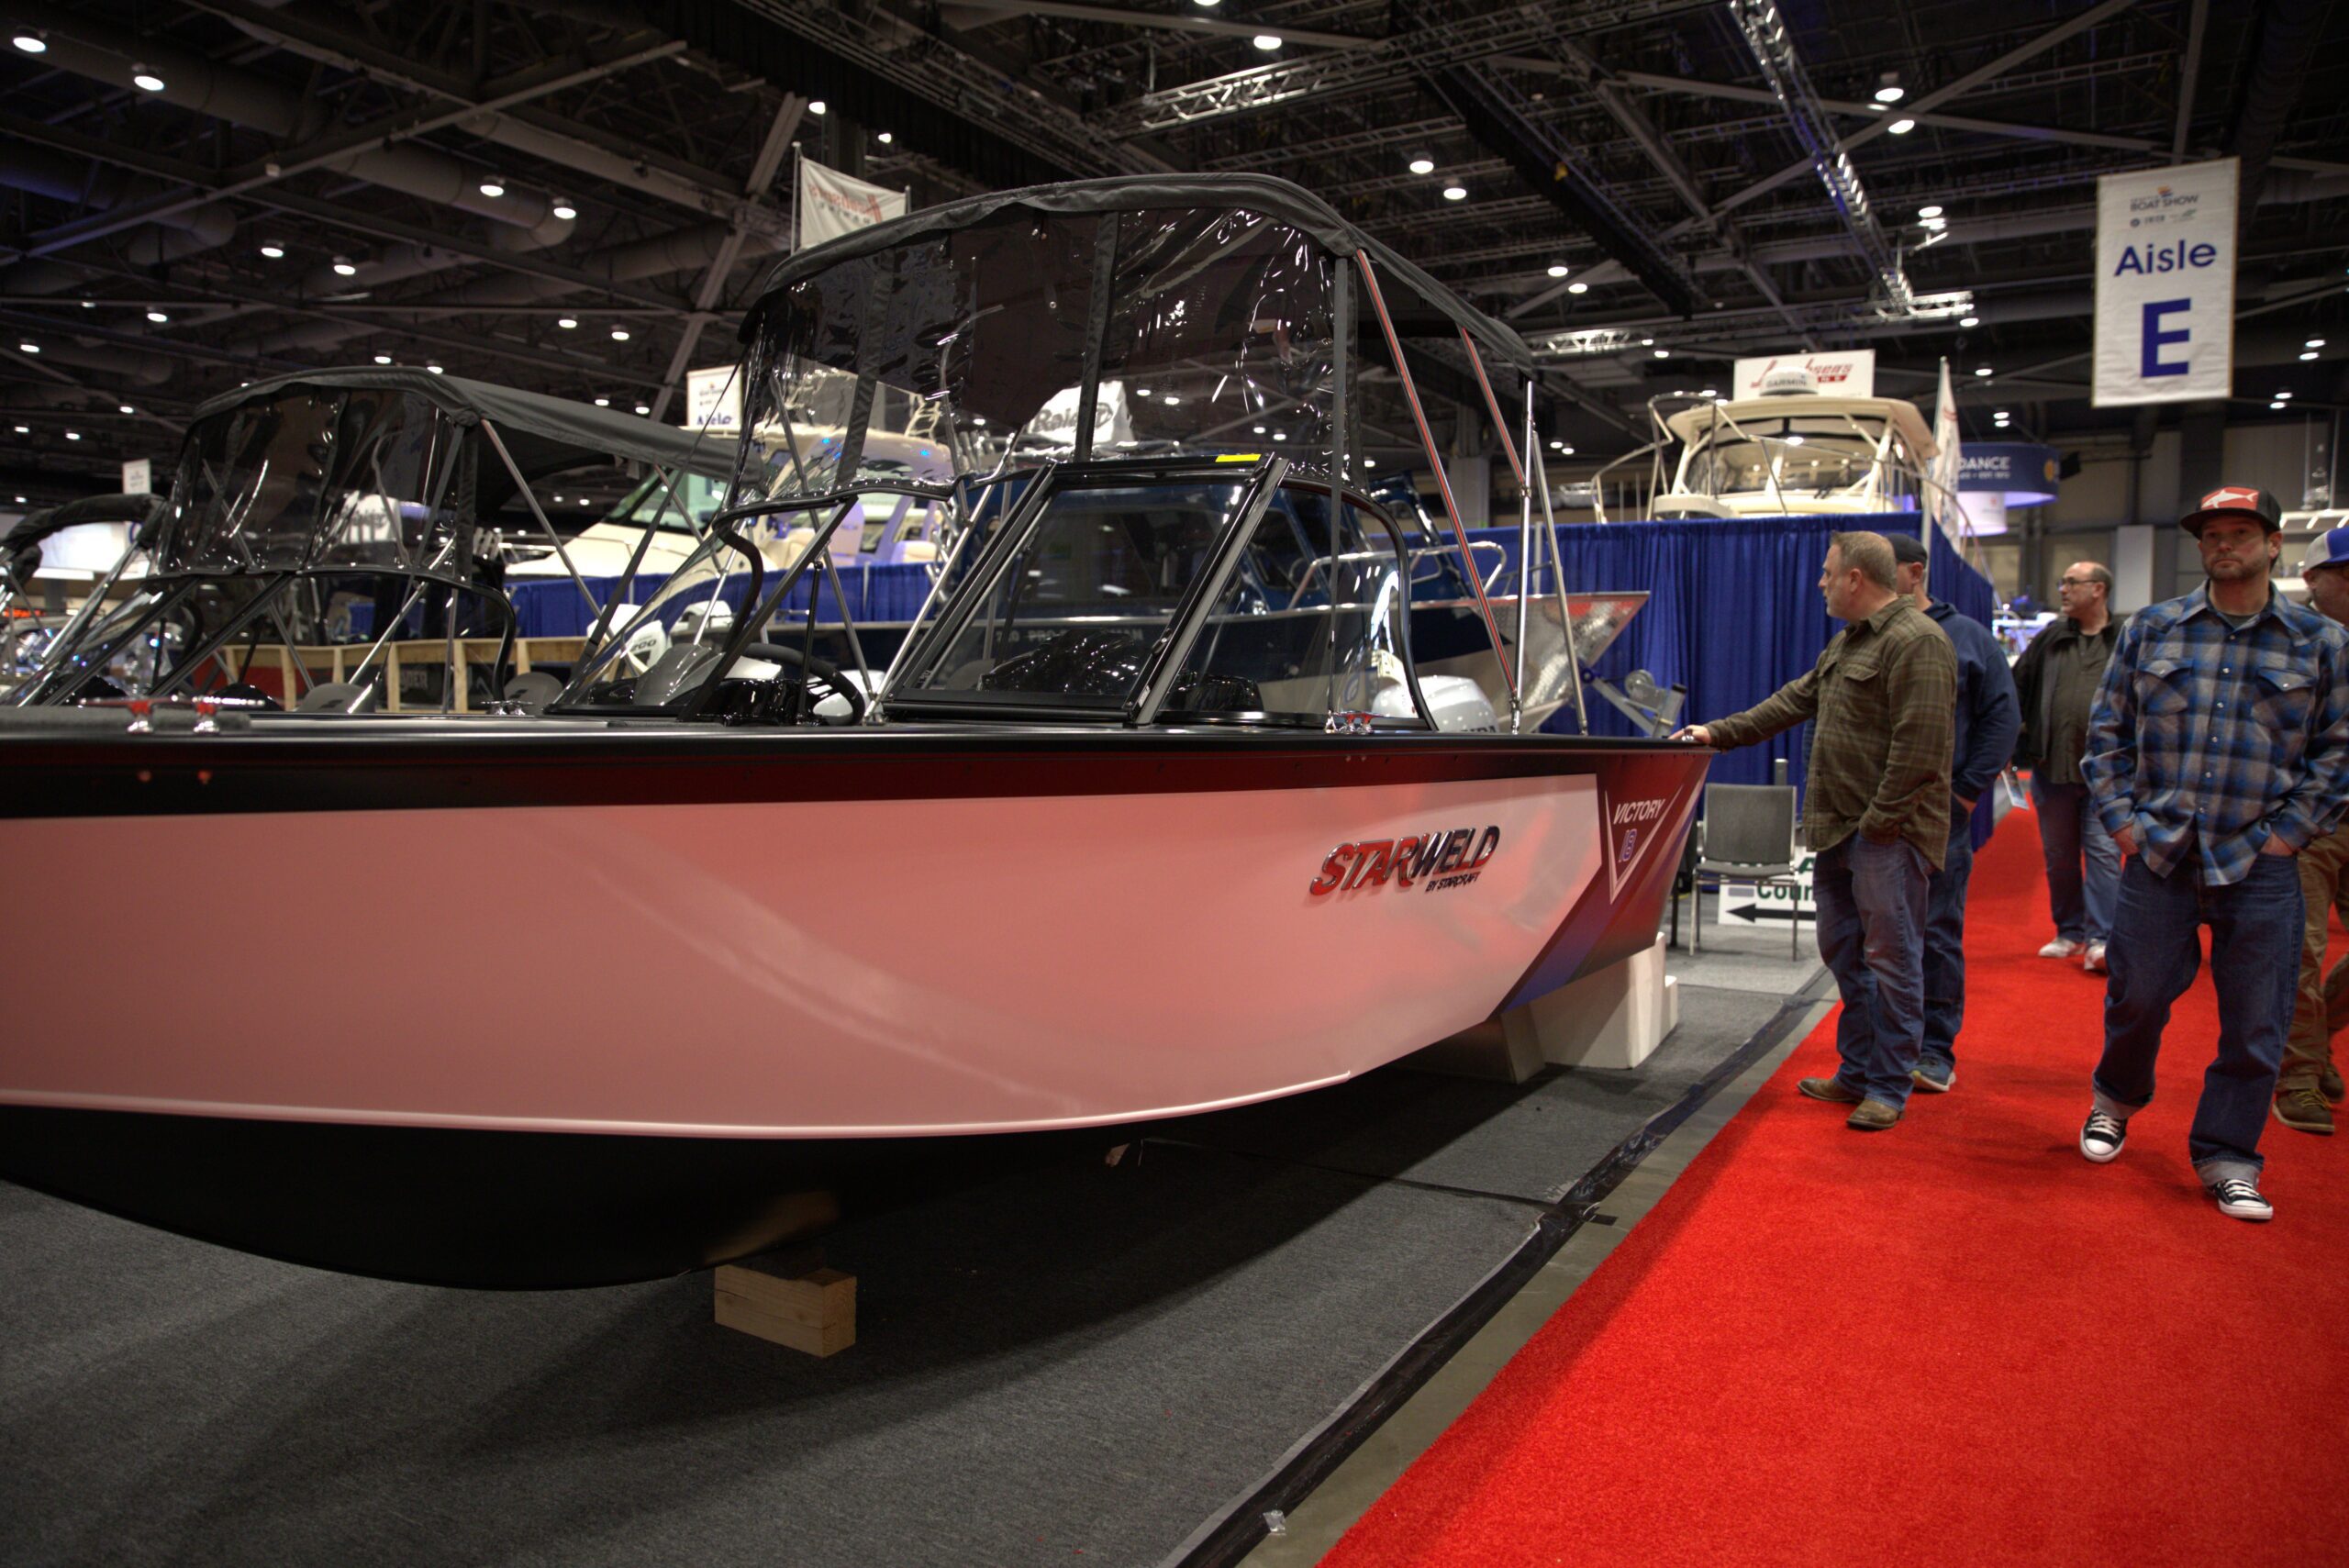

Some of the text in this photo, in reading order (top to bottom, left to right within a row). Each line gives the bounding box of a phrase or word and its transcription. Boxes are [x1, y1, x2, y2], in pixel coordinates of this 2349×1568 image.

[2130, 199, 2160, 213] BOAT
[2162, 194, 2199, 208] SHOW
[2113, 239, 2217, 277] Aisle
[2140, 297, 2191, 378] E
[1613, 798, 1666, 825] VICTORY
[1309, 825, 1500, 896] STARWELD
[1618, 828, 1638, 863] 18
[1425, 871, 1482, 892] BY STARCRAFT
